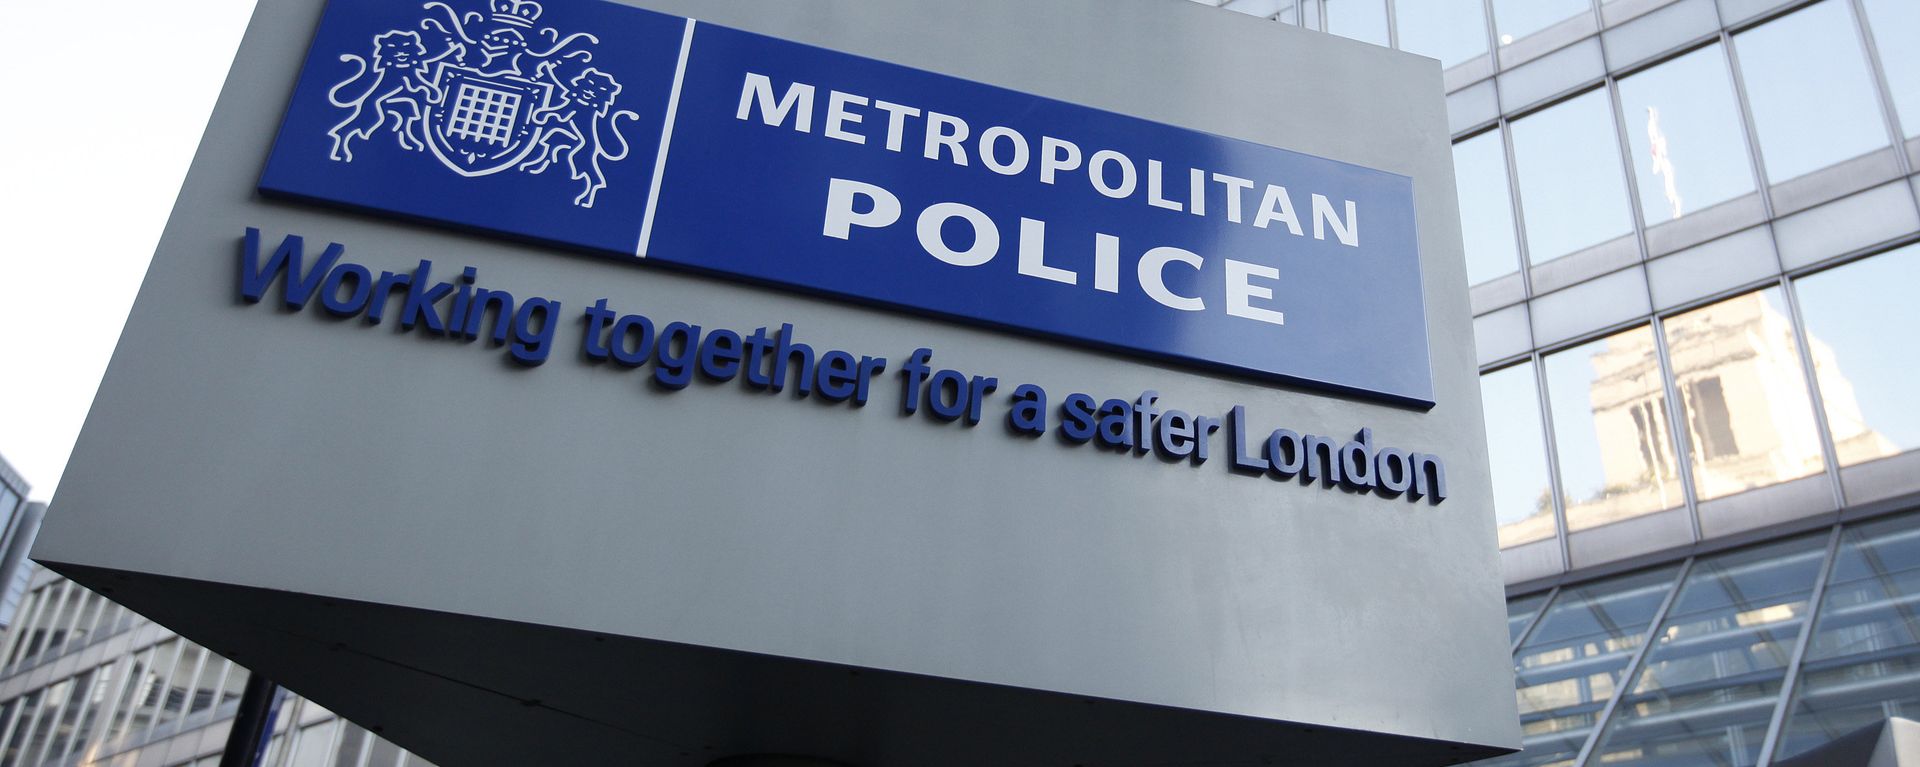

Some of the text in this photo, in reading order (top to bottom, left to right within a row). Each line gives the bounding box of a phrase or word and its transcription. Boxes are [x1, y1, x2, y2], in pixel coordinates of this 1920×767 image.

[736, 72, 1360, 247] METROPOLITAN
[823, 177, 1285, 325] POLICE
[236, 227, 1447, 503] Working together for a safer London
